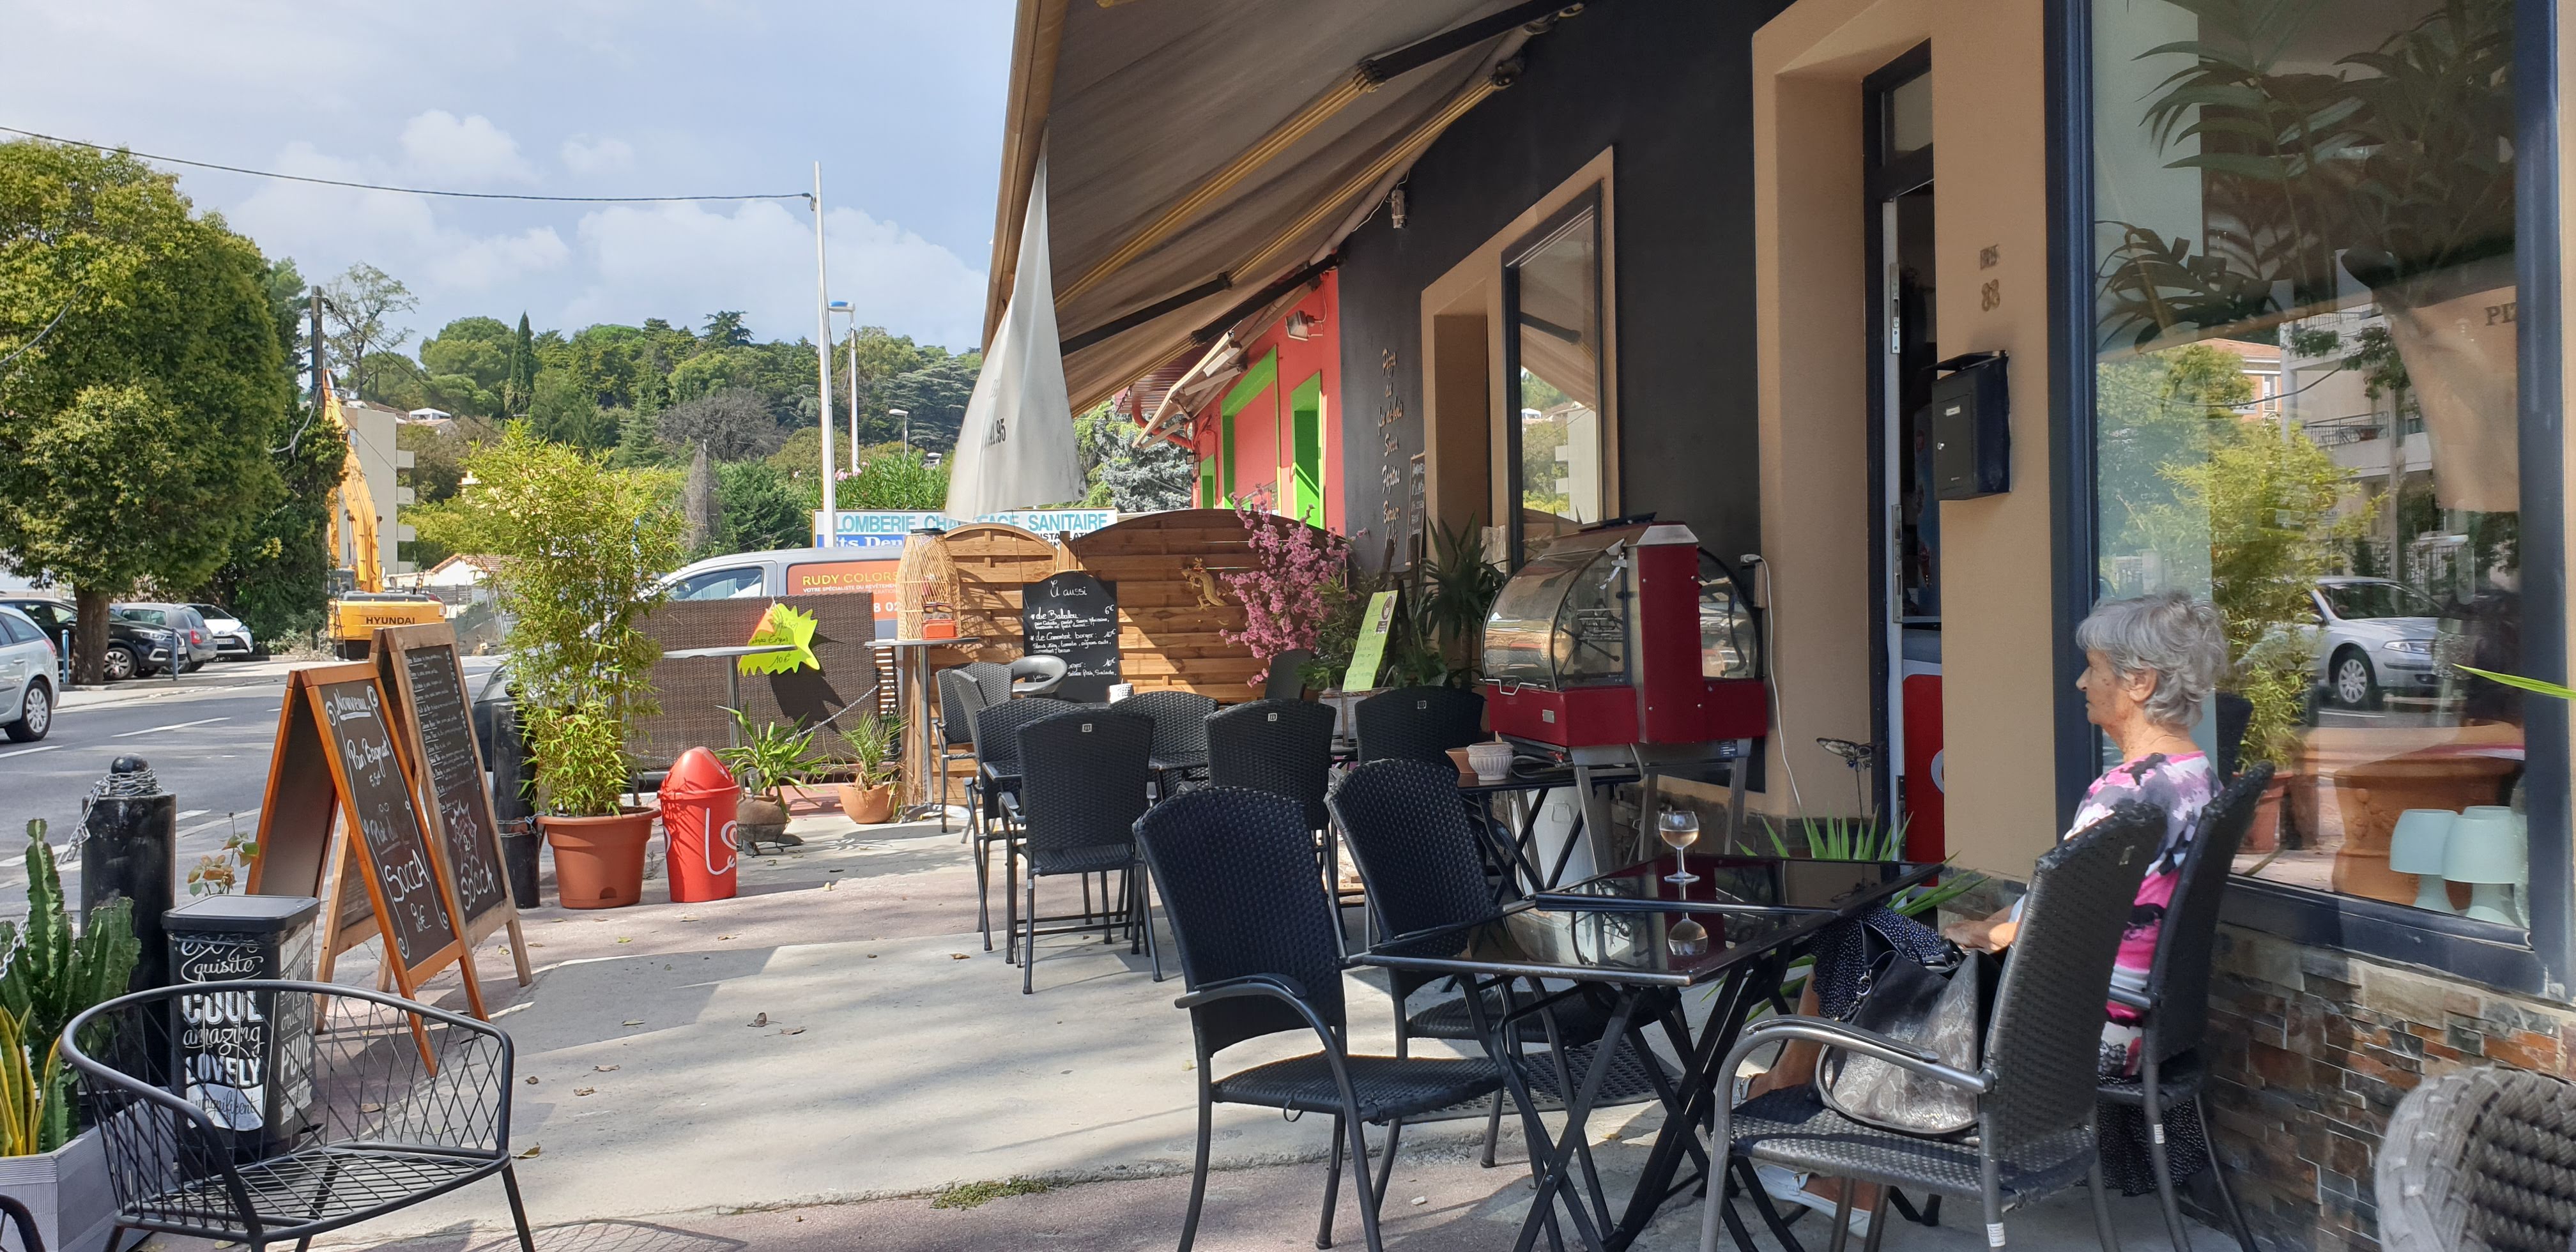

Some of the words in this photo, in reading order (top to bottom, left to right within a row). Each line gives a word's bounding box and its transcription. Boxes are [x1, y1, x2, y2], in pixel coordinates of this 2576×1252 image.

[836, 515, 916, 533] LOMBERIE
[1029, 513, 1107, 531] SANITAIRE
[802, 574, 839, 586] RUDY
[1062, 586, 1087, 596] aussi
[366, 616, 415, 625] HYUNDAI
[385, 848, 430, 903] SOCCA
[461, 860, 496, 912] SOCCA
[182, 990, 265, 1023] COOL
[183, 1025, 265, 1057] amazing
[185, 1053, 262, 1086] LOVELY
